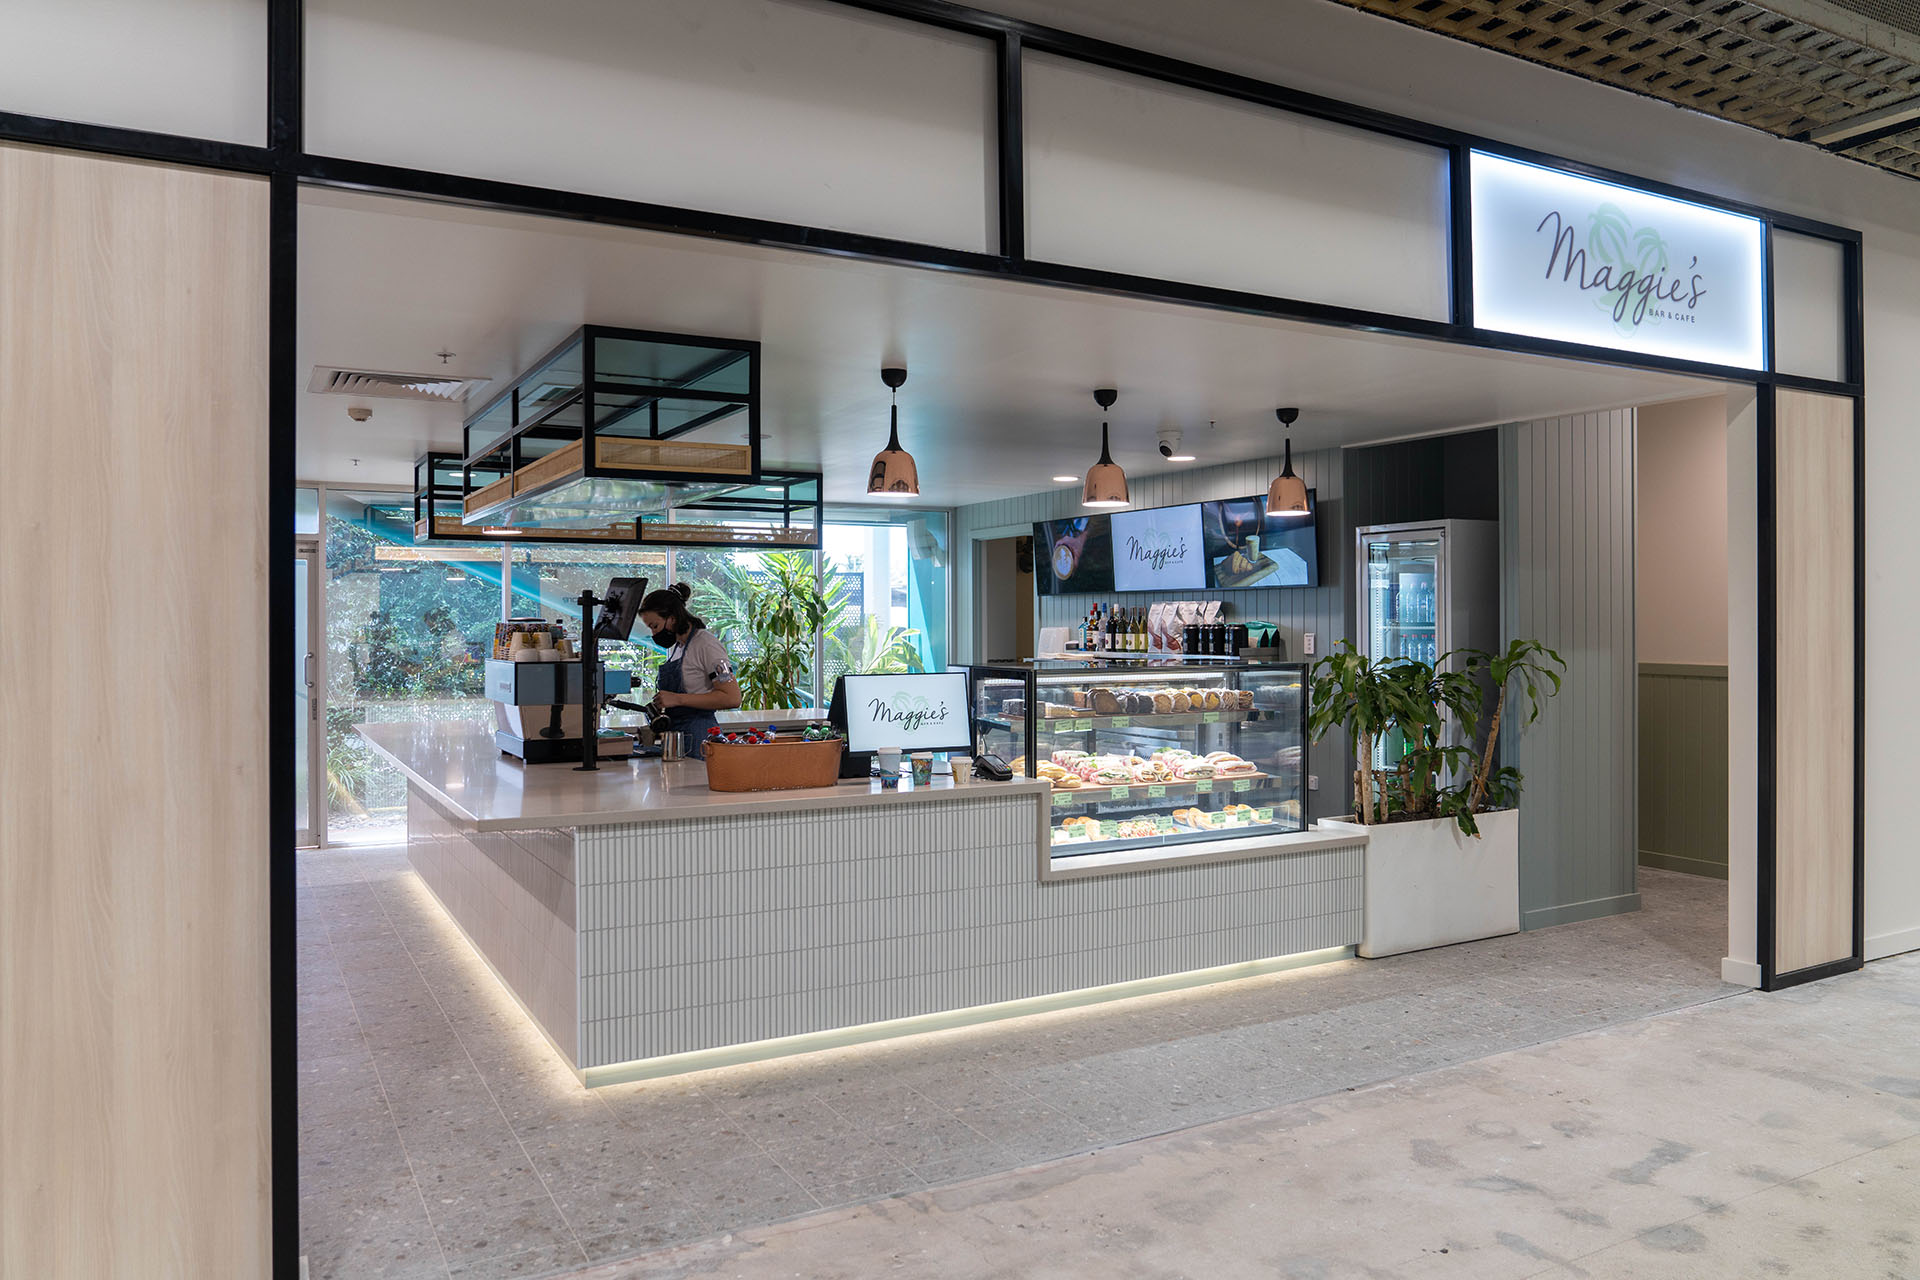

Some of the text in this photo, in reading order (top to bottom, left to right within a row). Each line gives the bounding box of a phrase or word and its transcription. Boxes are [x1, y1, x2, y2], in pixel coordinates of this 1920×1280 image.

[1537, 210, 1706, 325] Maggie's
[1648, 308, 1695, 323] BAR & CAFE
[1126, 535, 1188, 570] Maggie's
[868, 697, 949, 731] Maggie's
